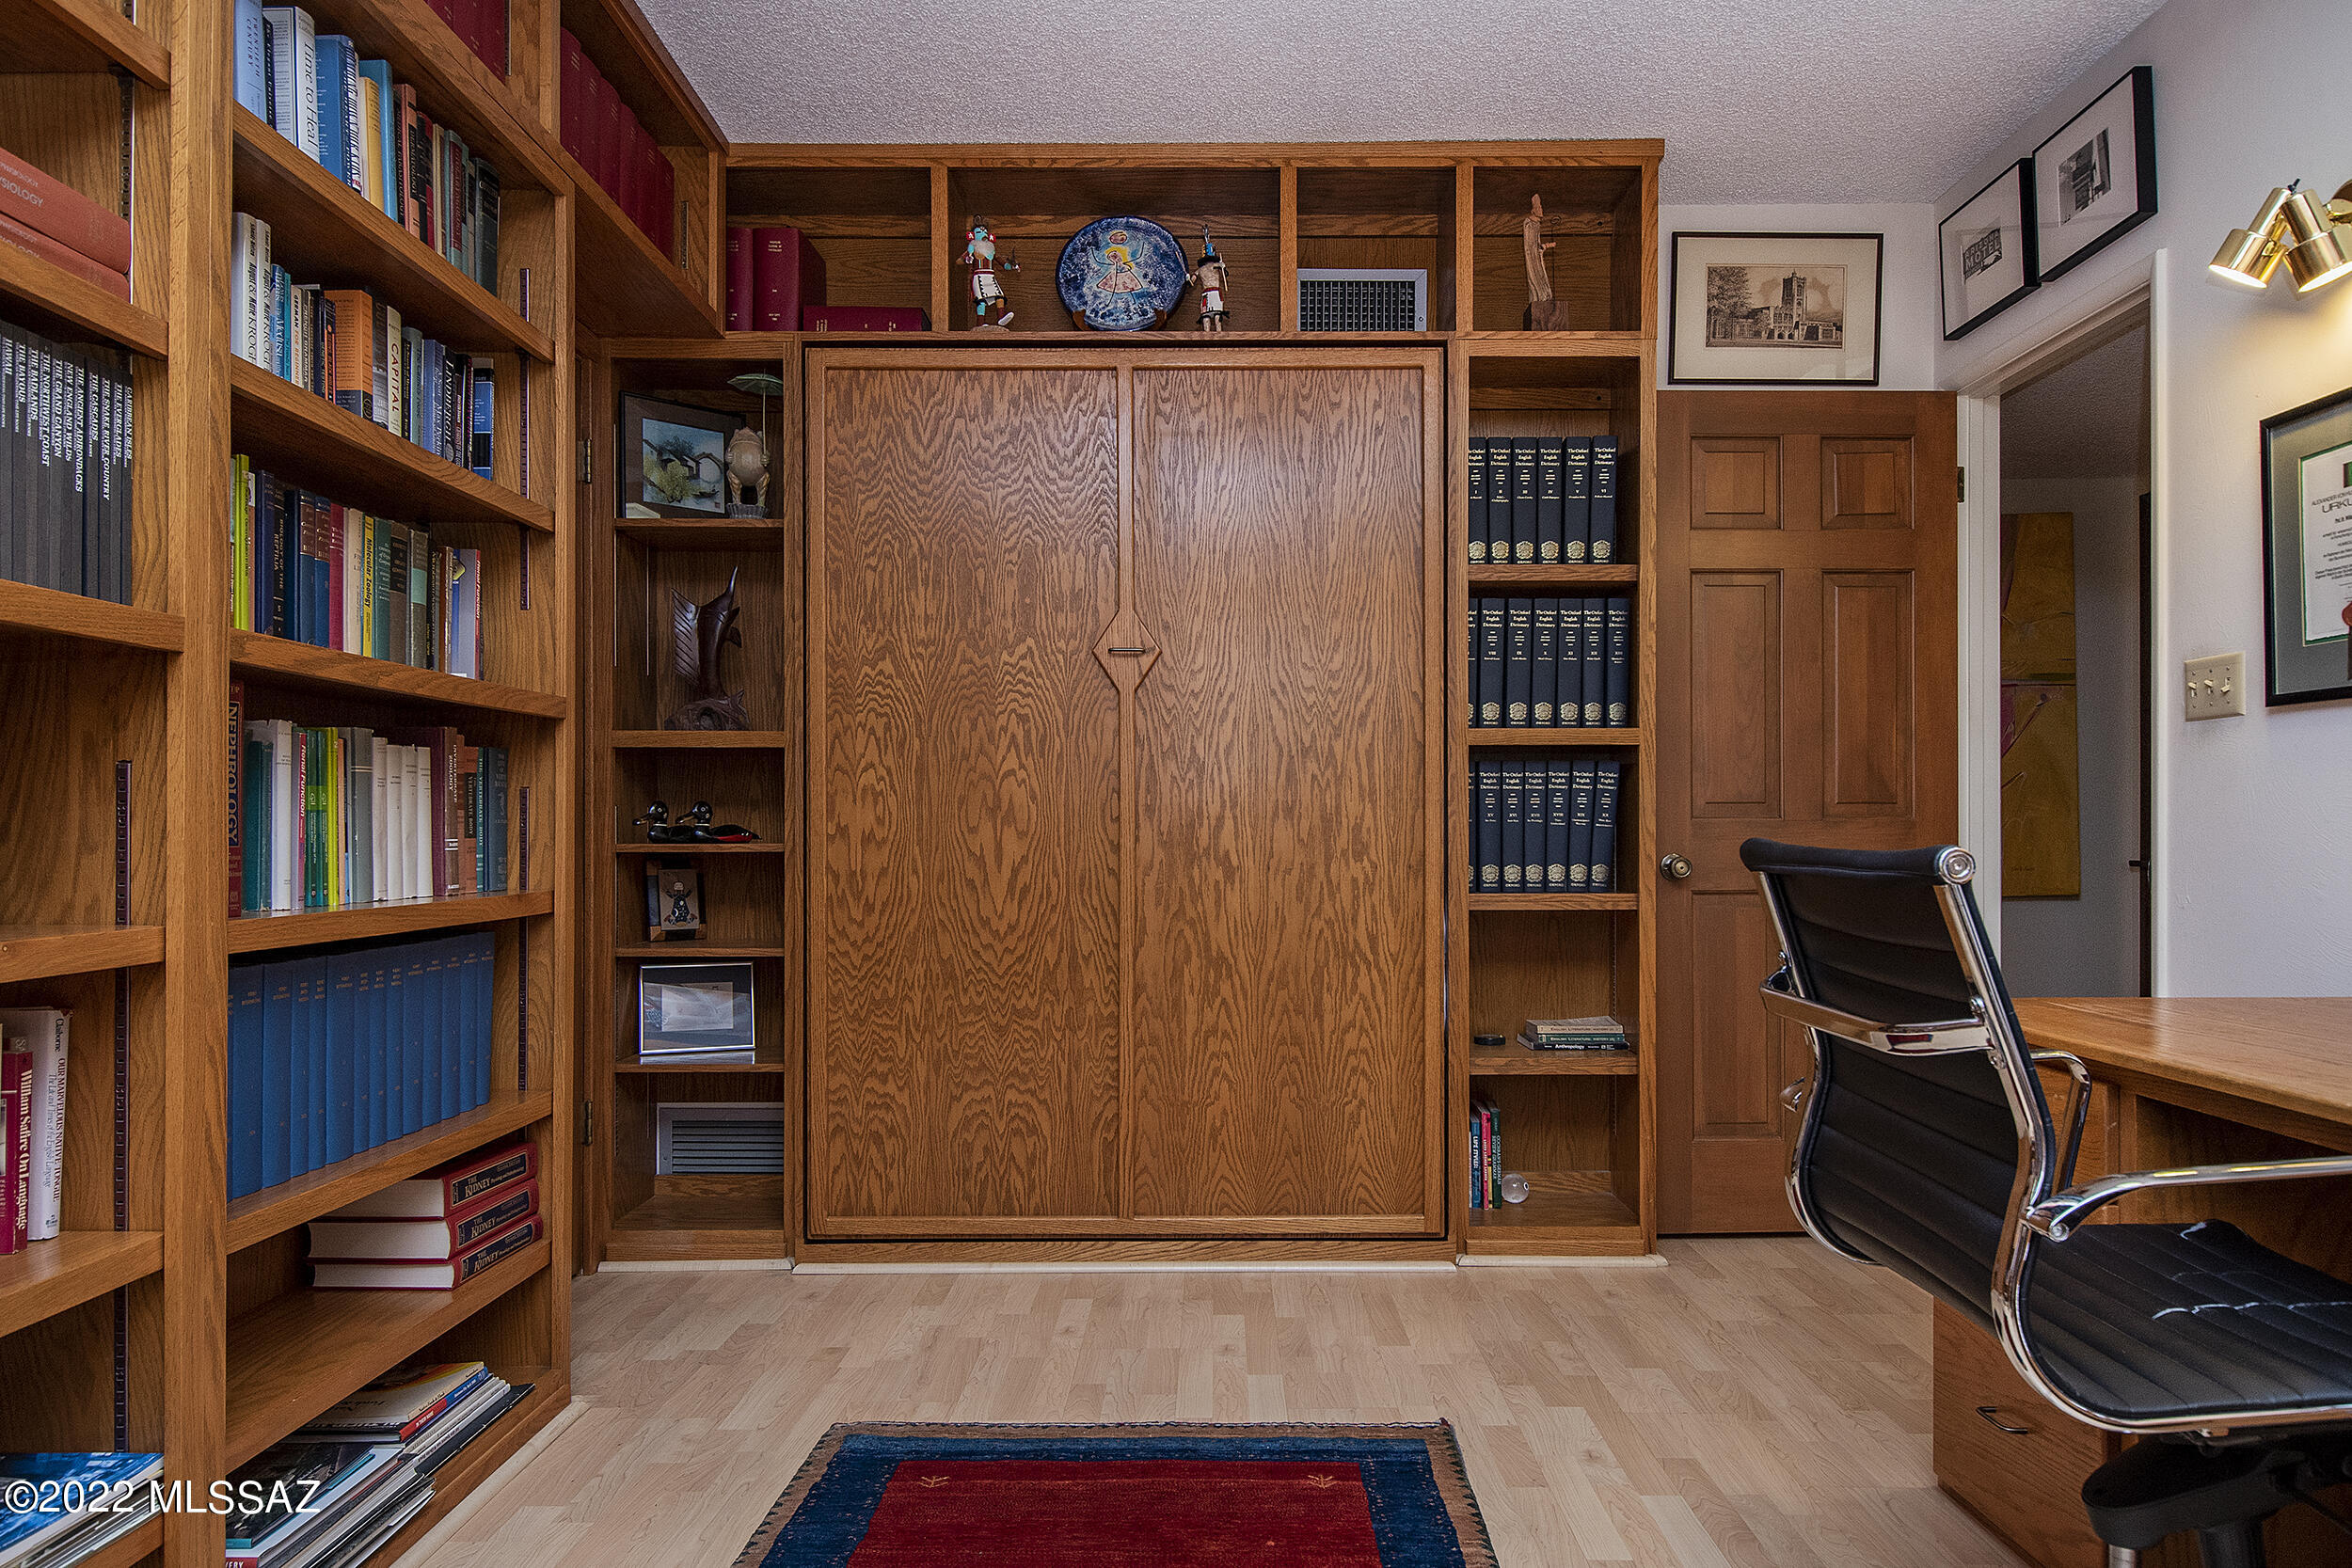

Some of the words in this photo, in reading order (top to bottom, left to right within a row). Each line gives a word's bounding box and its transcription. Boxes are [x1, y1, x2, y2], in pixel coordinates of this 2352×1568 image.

[304, 41, 314, 85] Time
[306, 86, 314, 103] to
[306, 105, 318, 148] Heal
[1965, 241, 2000, 270] MOTEL
[5, 339, 13, 375] HAWAII
[55, 359, 63, 378] THE
[18, 365, 26, 404] BAYOUS
[30, 370, 39, 420] BADLANDS
[391, 343, 400, 412] CAPITAL
[42, 375, 51, 434] NORTHWEST
[55, 380, 63, 416] GRAND
[445, 360, 454, 441] LINDBERGH
[41, 435, 50, 467] COAST
[54, 417, 62, 458] CANYON
[75, 428, 84, 492] ADIRONDACKS
[102, 457, 110, 500] COUNTRY
[364, 578, 373, 609] Zoology
[229, 707, 239, 843] NEPHROLOGY
[55, 1018, 65, 1053] Claiborne
[57, 1057, 66, 1077] OUR
[20, 1069, 33, 1115] William
[56, 1077, 66, 1130] MARVELOUS
[19, 1116, 32, 1151] Safire
[45, 1140, 55, 1161] English
[55, 1132, 64, 1164] NATIVE
[19, 1152, 31, 1172] On
[44, 1161, 55, 1188] Language
[16, 1173, 30, 1230] Language
[53, 1166, 62, 1202] TONGUE
[465, 1178, 491, 1197] KIDNEY
[470, 1218, 497, 1239] KIDNEY
[474, 1250, 500, 1273] KIDNEY
